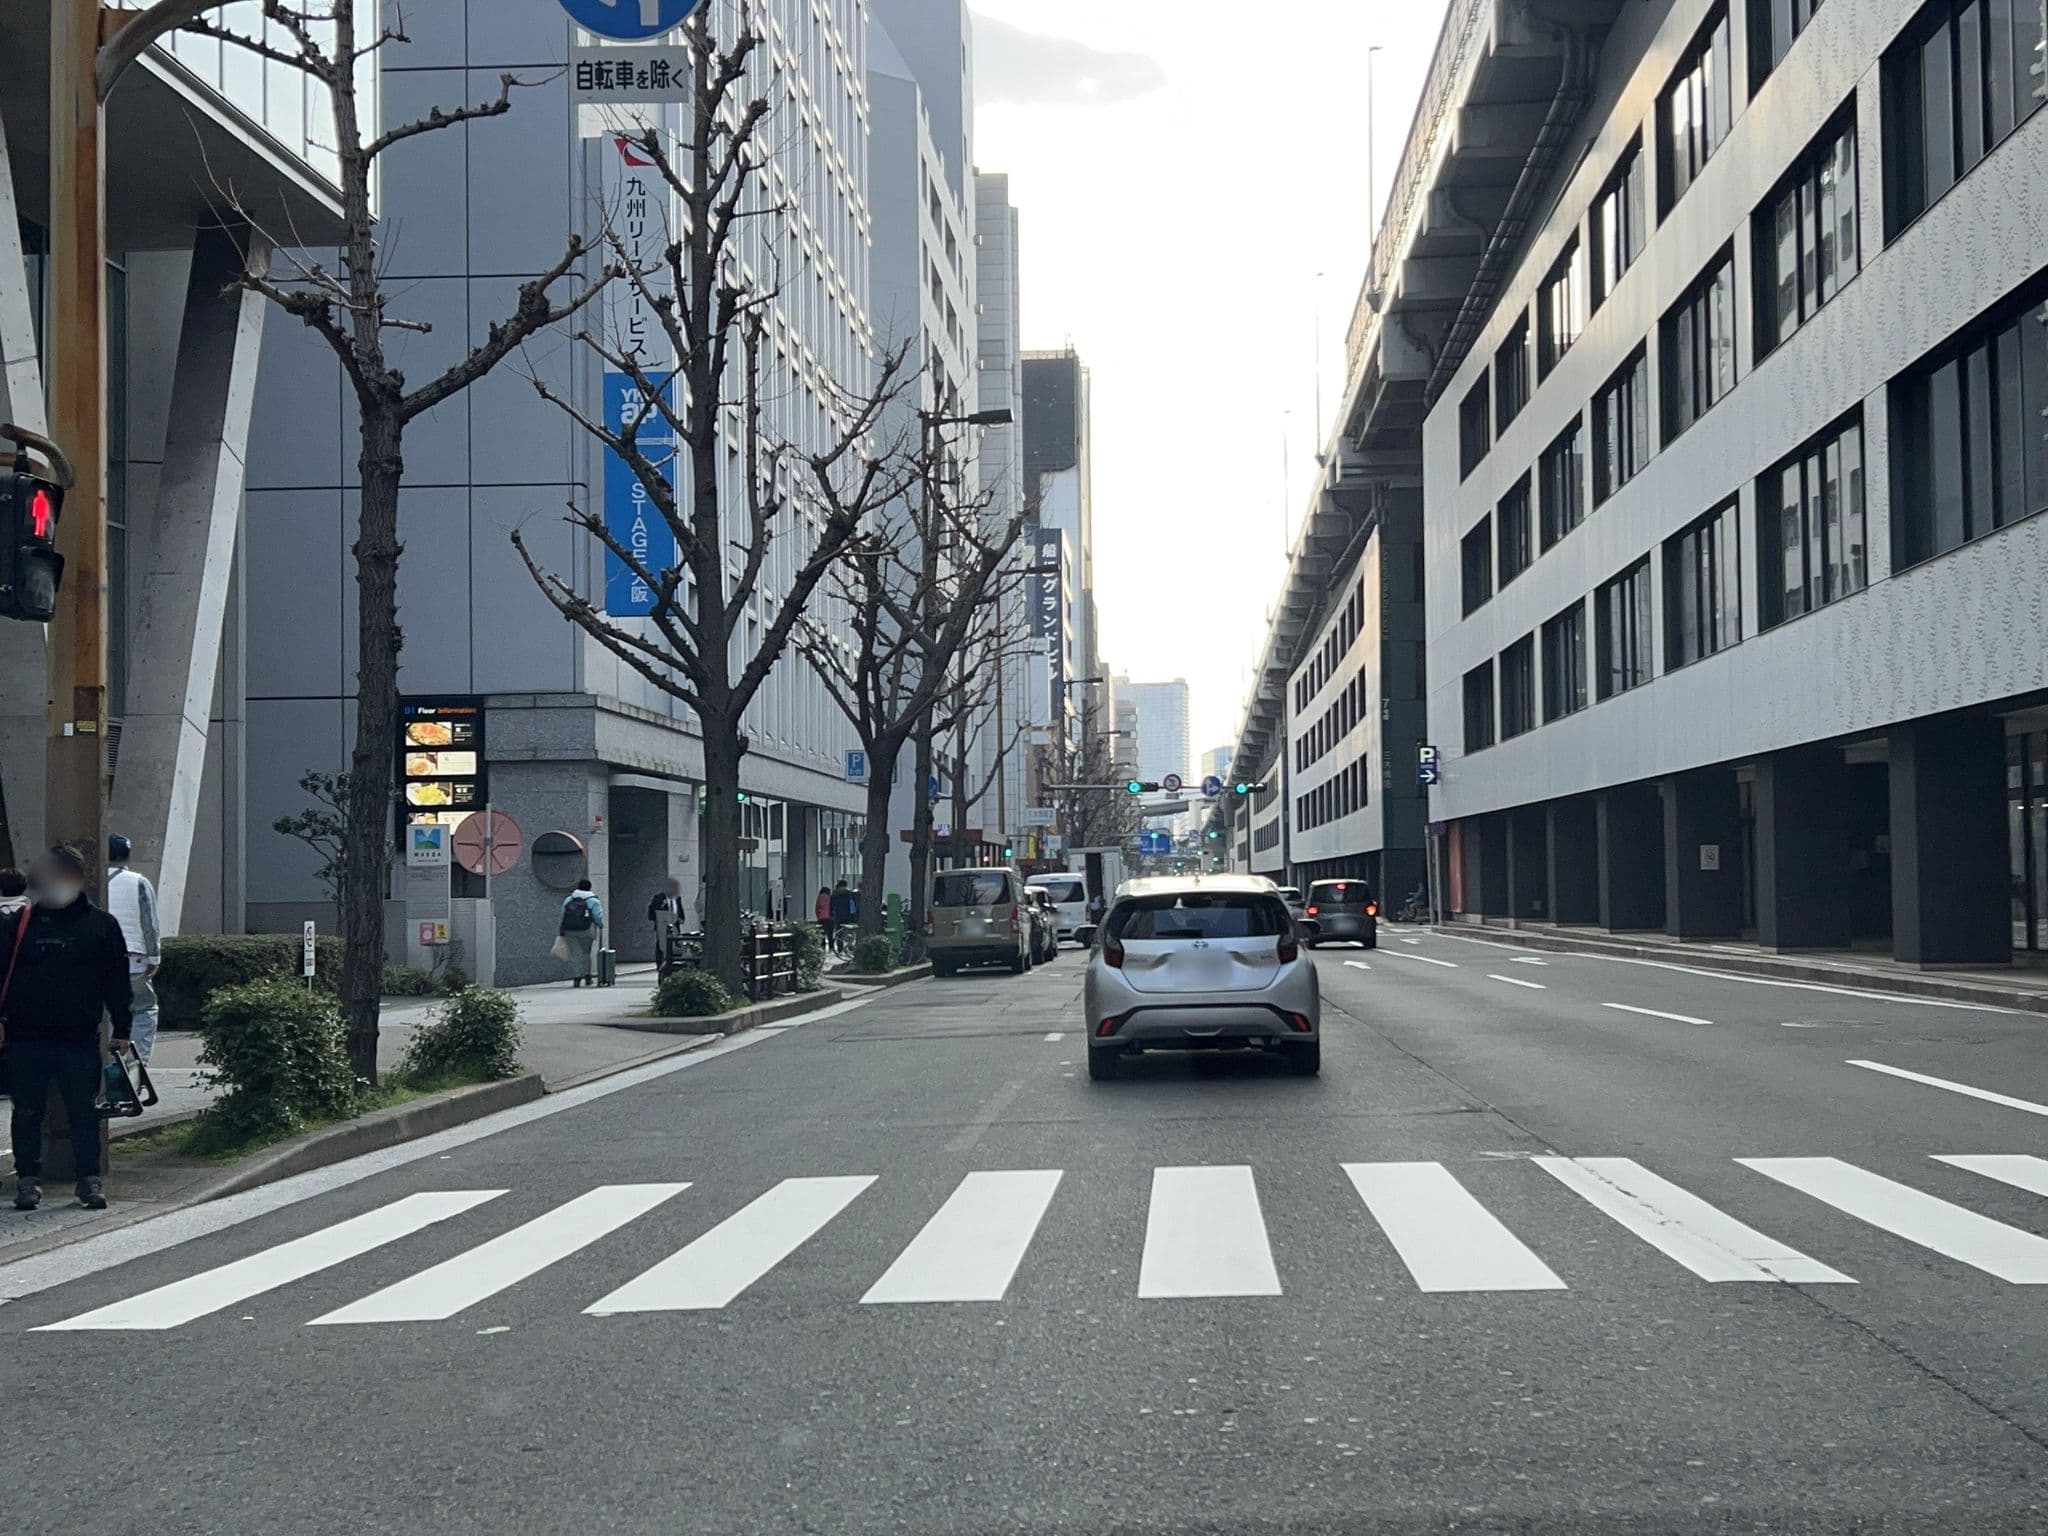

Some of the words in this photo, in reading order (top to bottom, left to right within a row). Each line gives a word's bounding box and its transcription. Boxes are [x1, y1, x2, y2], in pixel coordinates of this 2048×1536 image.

[577, 60, 683, 90] 自転車を除く
[626, 176, 648, 356] 九州リースサービス
[1042, 543, 1059, 681] 船グランドビル
[852, 754, 862, 767] P
